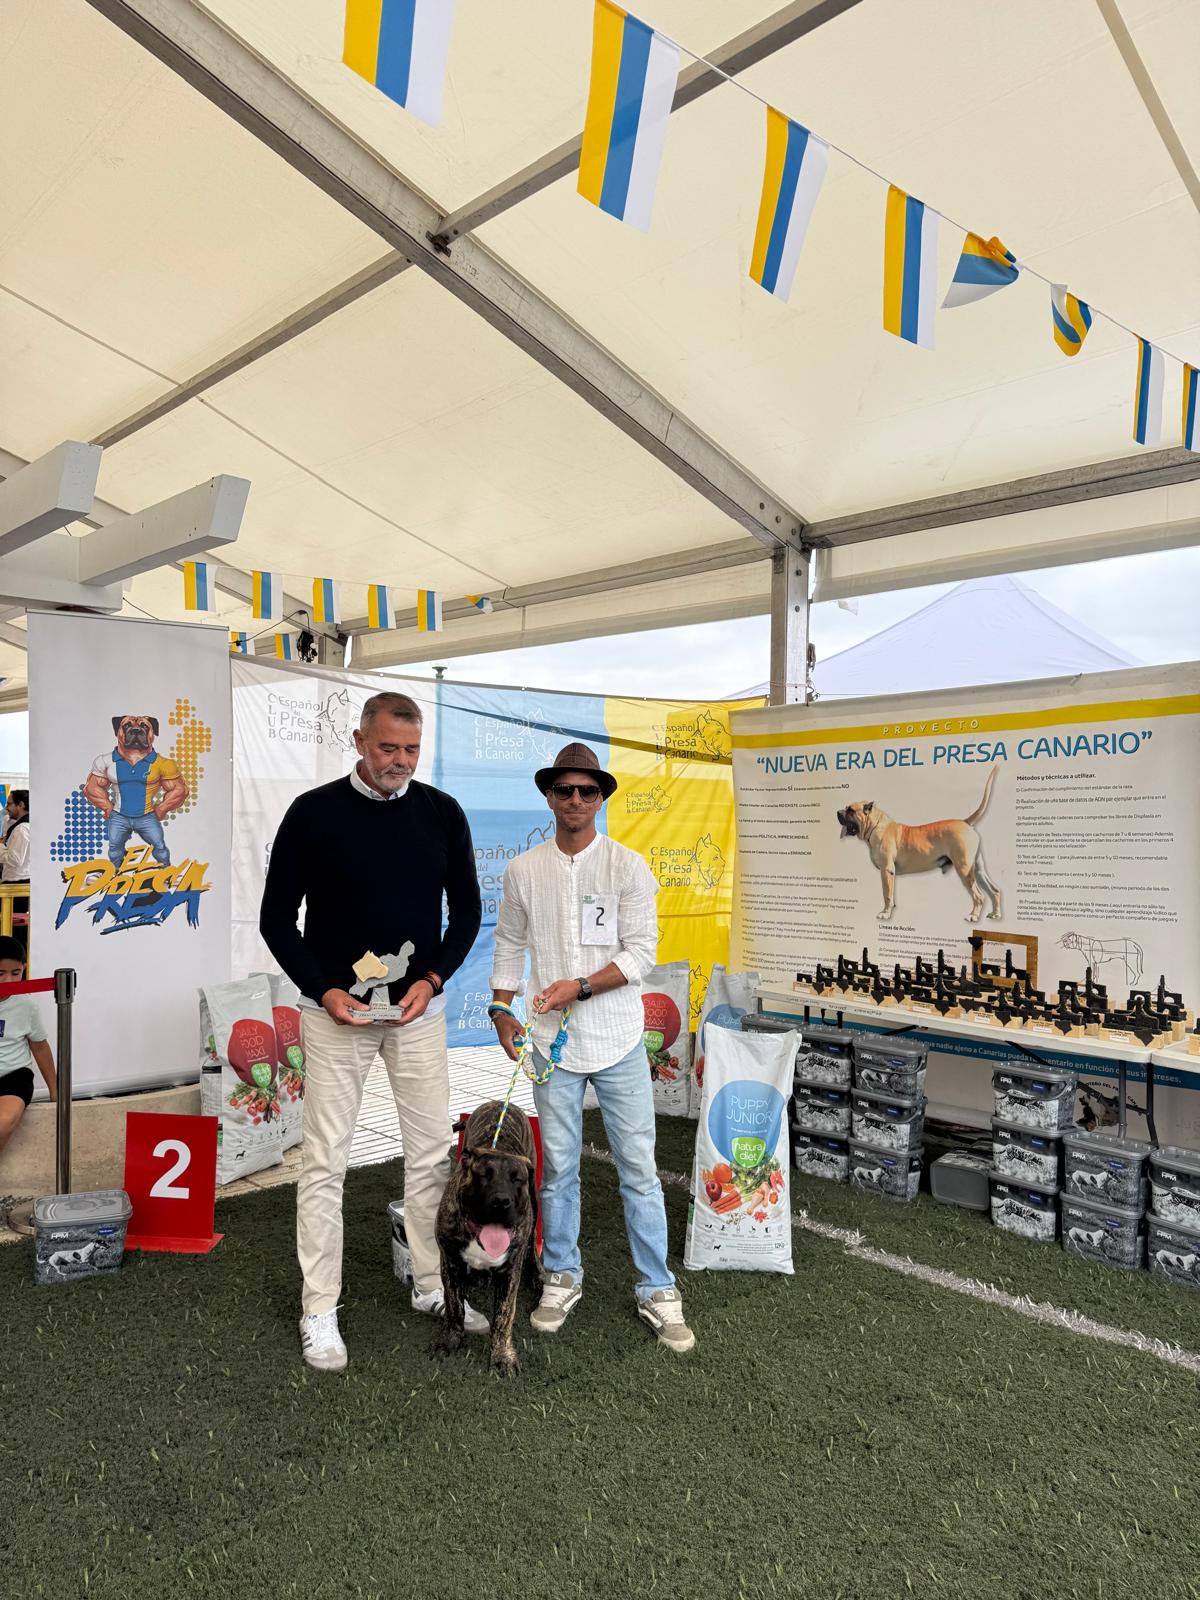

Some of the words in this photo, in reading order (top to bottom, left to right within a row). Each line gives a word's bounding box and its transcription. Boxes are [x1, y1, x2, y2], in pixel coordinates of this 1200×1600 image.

[279, 695, 324, 711] Español
[281, 711, 321, 731] Presa
[486, 719, 525, 730] Español
[882, 719, 980, 735] PROYECTO
[279, 727, 323, 745] Canario
[486, 733, 524, 747] Presa
[665, 737, 697, 749] Presa
[485, 747, 524, 760] Canario
[665, 749, 698, 760] Canario
[835, 751, 876, 770] ERA
[883, 746, 923, 768] DEL
[933, 741, 1009, 765] PRESA
[121, 845, 161, 873] EL
[474, 844, 521, 860] pañol
[660, 847, 694, 857] Español
[478, 863, 488, 872] del
[660, 861, 692, 873] Presa
[659, 875, 691, 887] Canario
[596, 907, 604, 926] 2
[954, 1045, 972, 1053] ajeno
[979, 1048, 1007, 1058] Canarias
[1008, 1053, 1029, 1062] pueda
[1085, 1062, 1114, 1073] función
[731, 1095, 769, 1110] PUPPY
[726, 1109, 773, 1125] JUNIOR
[740, 1151, 757, 1160] diet
[149, 1139, 192, 1199] 2
